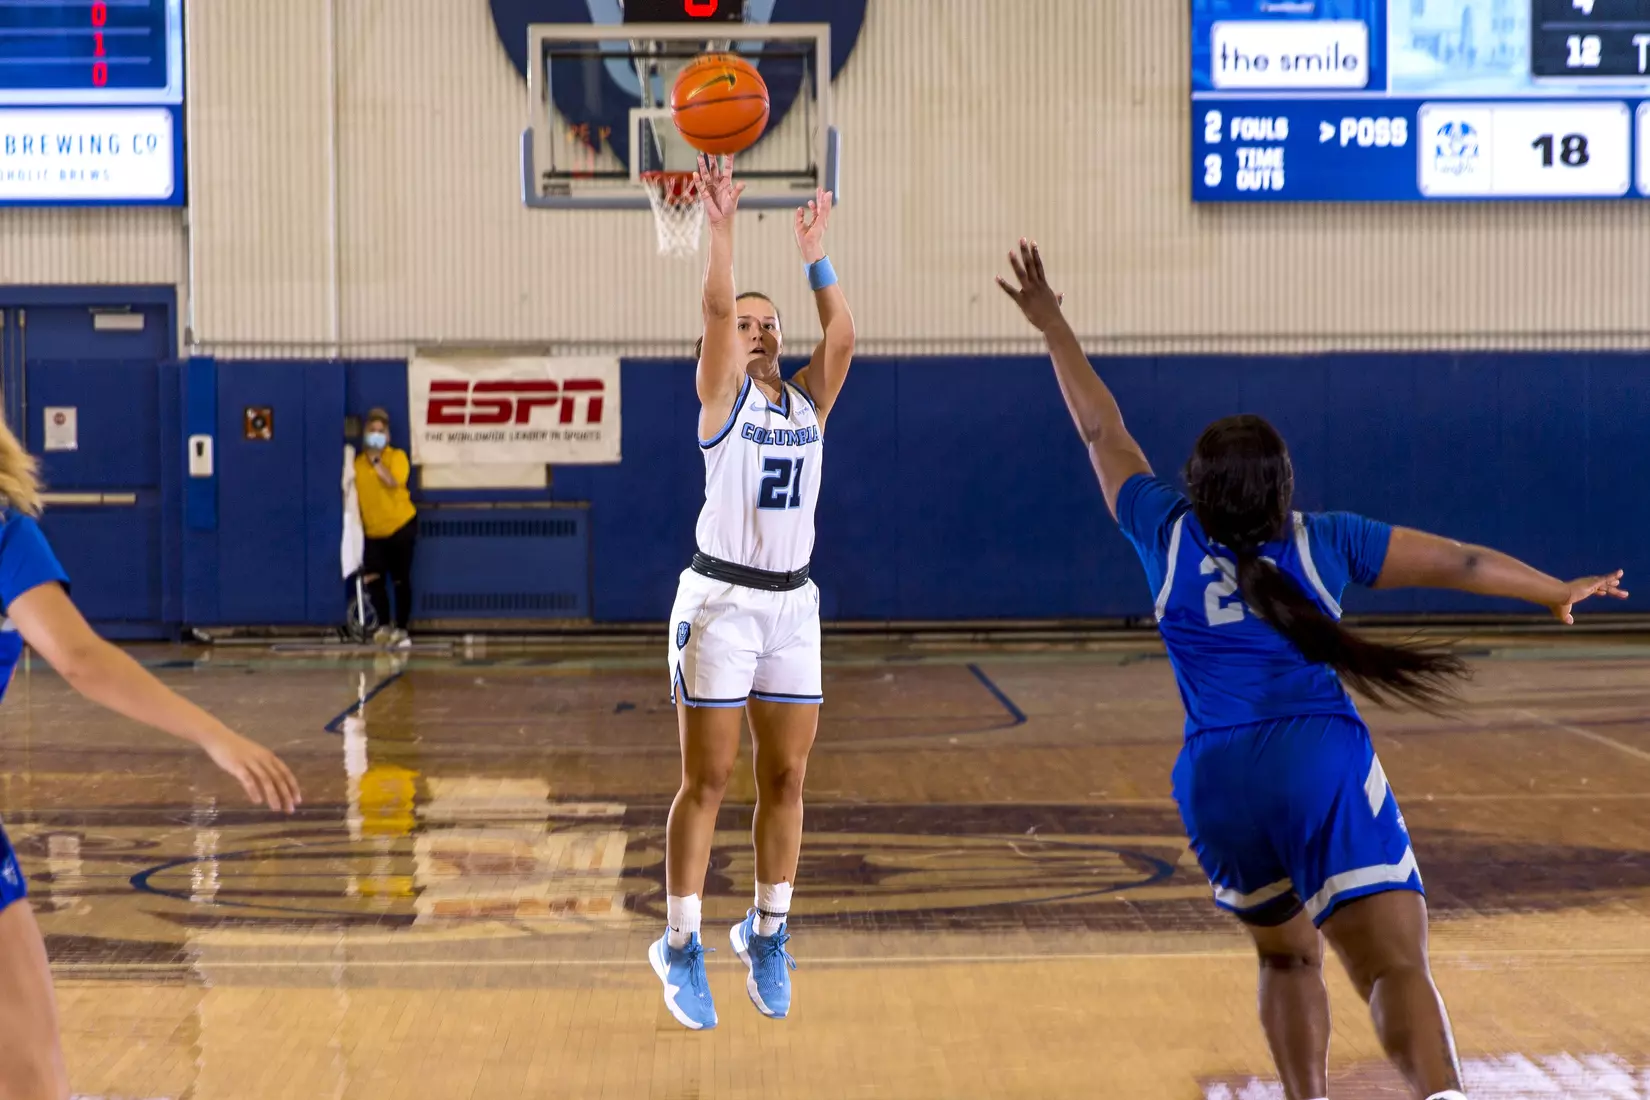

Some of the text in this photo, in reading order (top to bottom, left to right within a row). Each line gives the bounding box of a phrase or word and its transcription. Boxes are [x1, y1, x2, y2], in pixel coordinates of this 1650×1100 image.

[91, 2, 107, 28] 0
[93, 31, 107, 57] 1
[1221, 41, 1358, 72] the smile
[1566, 34, 1601, 68] 12
[92, 62, 108, 88] 0
[1204, 110, 1289, 144] 2 FOULS
[1340, 116, 1408, 147] POSS
[5, 133, 120, 156] BREWING
[1532, 133, 1590, 168] 18
[1204, 147, 1285, 187] 3 TIME
[1236, 168, 1285, 191] OUTS
[426, 379, 605, 425] ESPN
[425, 430, 601, 442] THE WORLDWIDE LEADER IN SPORTS
[741, 422, 820, 446] COLUMBIA
[757, 456, 805, 510] 21
